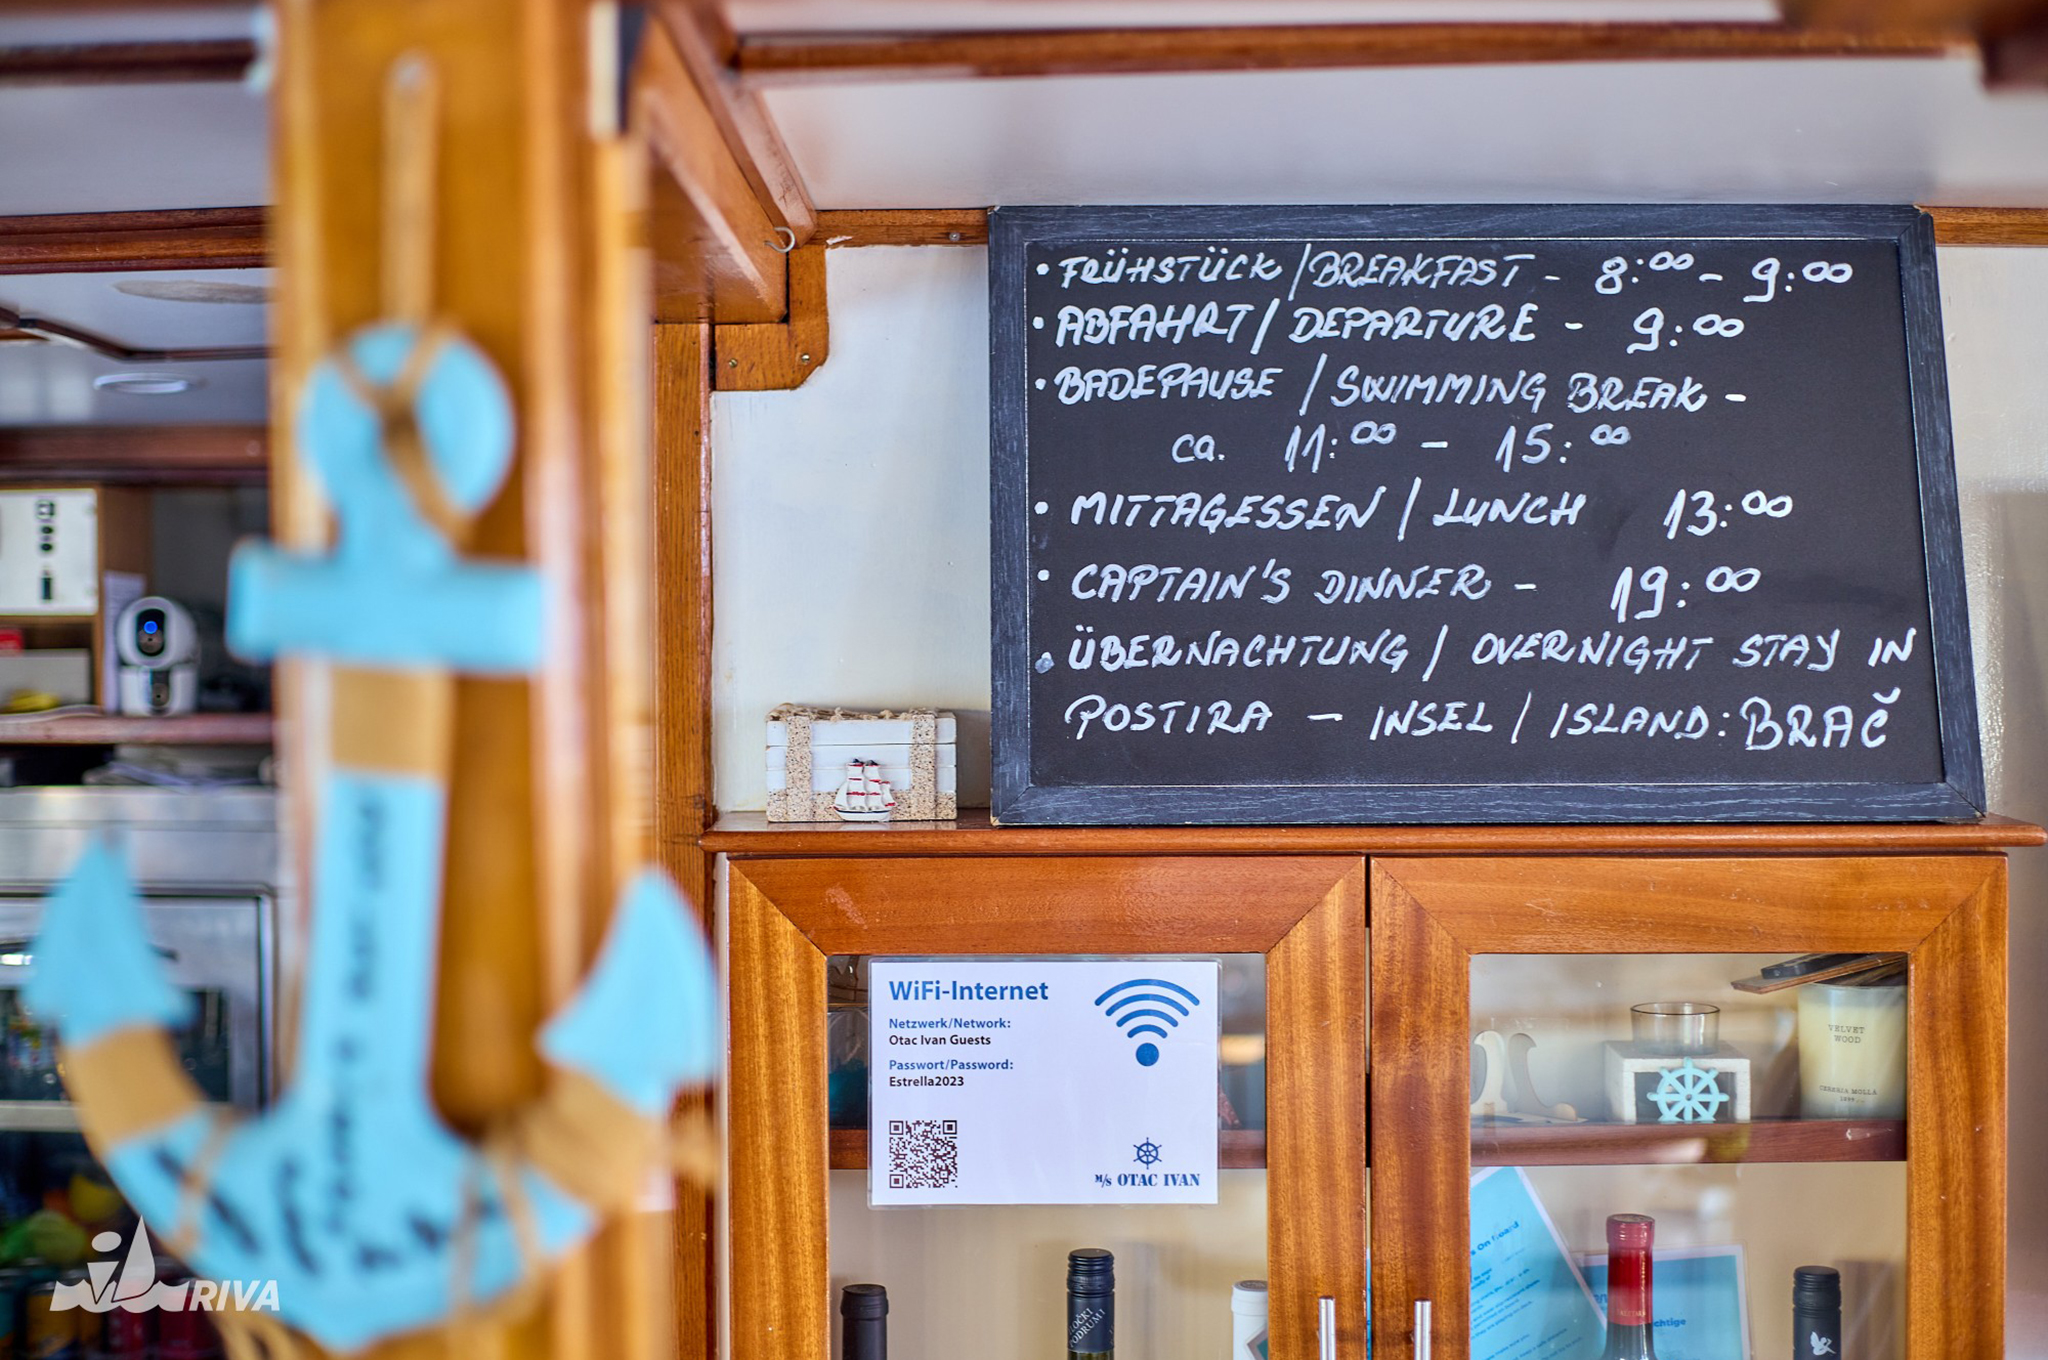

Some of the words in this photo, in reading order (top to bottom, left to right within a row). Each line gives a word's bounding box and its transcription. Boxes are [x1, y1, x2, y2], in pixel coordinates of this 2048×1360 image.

[1289, 303, 1538, 343] DEPARTURE
[1054, 363, 1283, 404] BADEPAUSE
[1331, 365, 1546, 413] SWIMMING
[1568, 373, 1708, 413] BREAK
[1071, 486, 1387, 534] MITTAGESSEN
[1433, 488, 1586, 527] LUNCH
[1072, 559, 1291, 604] CAPTAIN'S
[1314, 564, 1491, 604] DINNER
[1069, 625, 1408, 673] ÜBERNACHTUNG
[1472, 630, 1713, 674] OVERNIGHT
[1732, 629, 1840, 671] STAY
[1868, 628, 1917, 667] IN
[1065, 694, 1273, 740] POSTIRA
[1370, 700, 1493, 740] INSEL
[889, 980, 1049, 1001] WiFi-Internet
[889, 1018, 1011, 1029] Netzwerk/Network:
[1828, 1024, 1866, 1034] VELVET
[889, 1035, 918, 1046] Otac
[920, 1035, 947, 1046] Ivan
[950, 1034, 992, 1046] Guests
[1833, 1035, 1862, 1044] WOOD
[889, 1059, 1014, 1071] Passwort/Password:
[889, 1076, 965, 1087] Estrella2023
[1117, 1173, 1158, 1187] OTAC
[1163, 1173, 1201, 1187] IVAN
